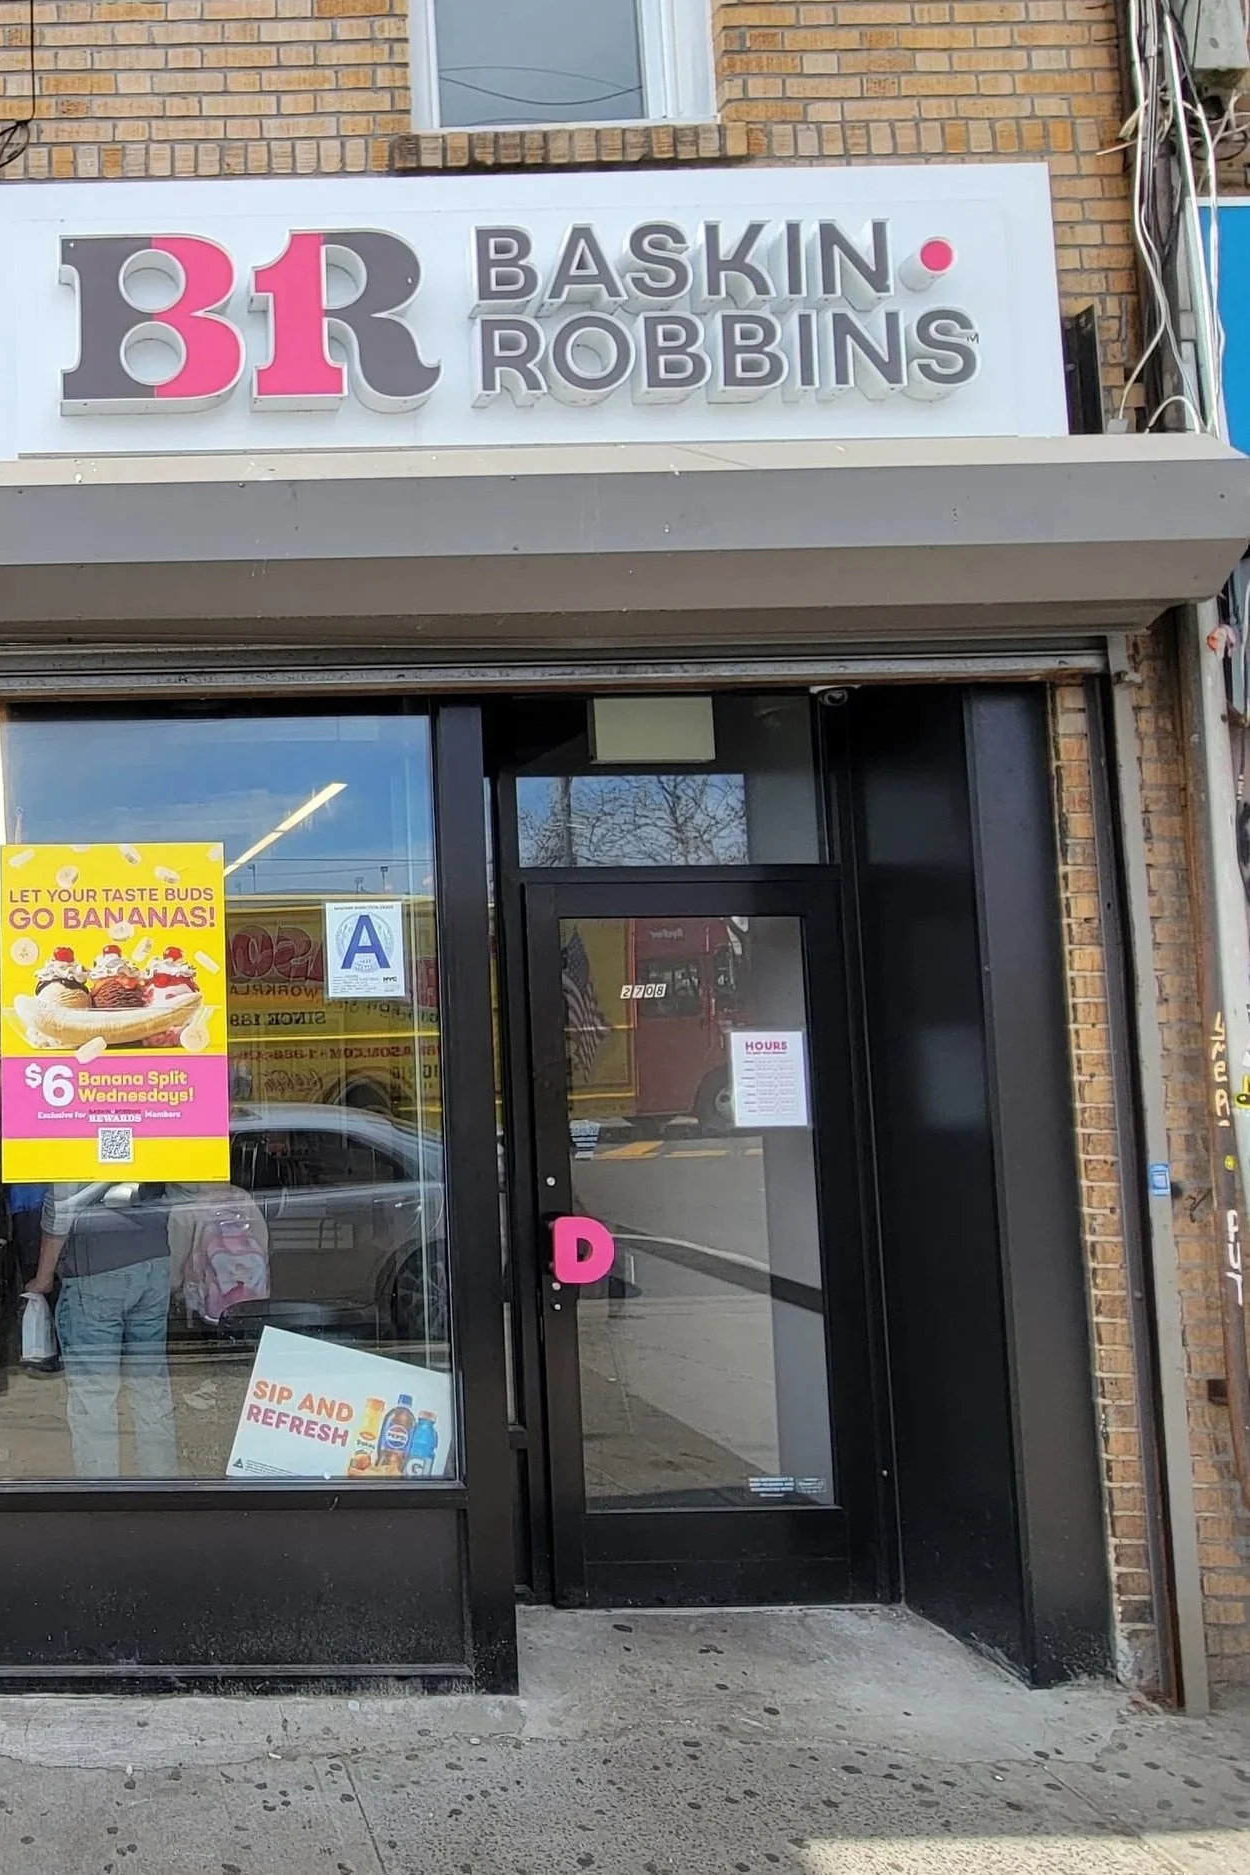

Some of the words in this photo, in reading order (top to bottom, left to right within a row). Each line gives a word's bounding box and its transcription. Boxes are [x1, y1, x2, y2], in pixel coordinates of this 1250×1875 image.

[474, 219, 893, 305] BASKIN
[60, 229, 443, 408] BR
[474, 309, 978, 397] ROBBINS
[9, 889, 42, 903] LET
[46, 888, 97, 903] YOUR
[102, 888, 159, 902] TASTE
[165, 887, 214, 901] BUDS
[8, 907, 55, 929] GO
[63, 905, 216, 929] BANANAS!
[341, 914, 391, 970] A
[622, 985, 665, 998] 2708
[745, 1041, 788, 1051] HOURS
[24, 1062, 75, 1107] $6
[78, 1071, 144, 1087] Banana
[147, 1070, 189, 1090] Split
[78, 1087, 194, 1106] Wednesdays!
[74, 1110, 87, 1120] for
[88, 1114, 143, 1123] REWARDS
[145, 1110, 181, 1119] Members
[554, 1216, 615, 1284] D
[253, 1380, 293, 1405] SIP
[298, 1393, 354, 1422] AND
[247, 1404, 349, 1448] REFRESH
